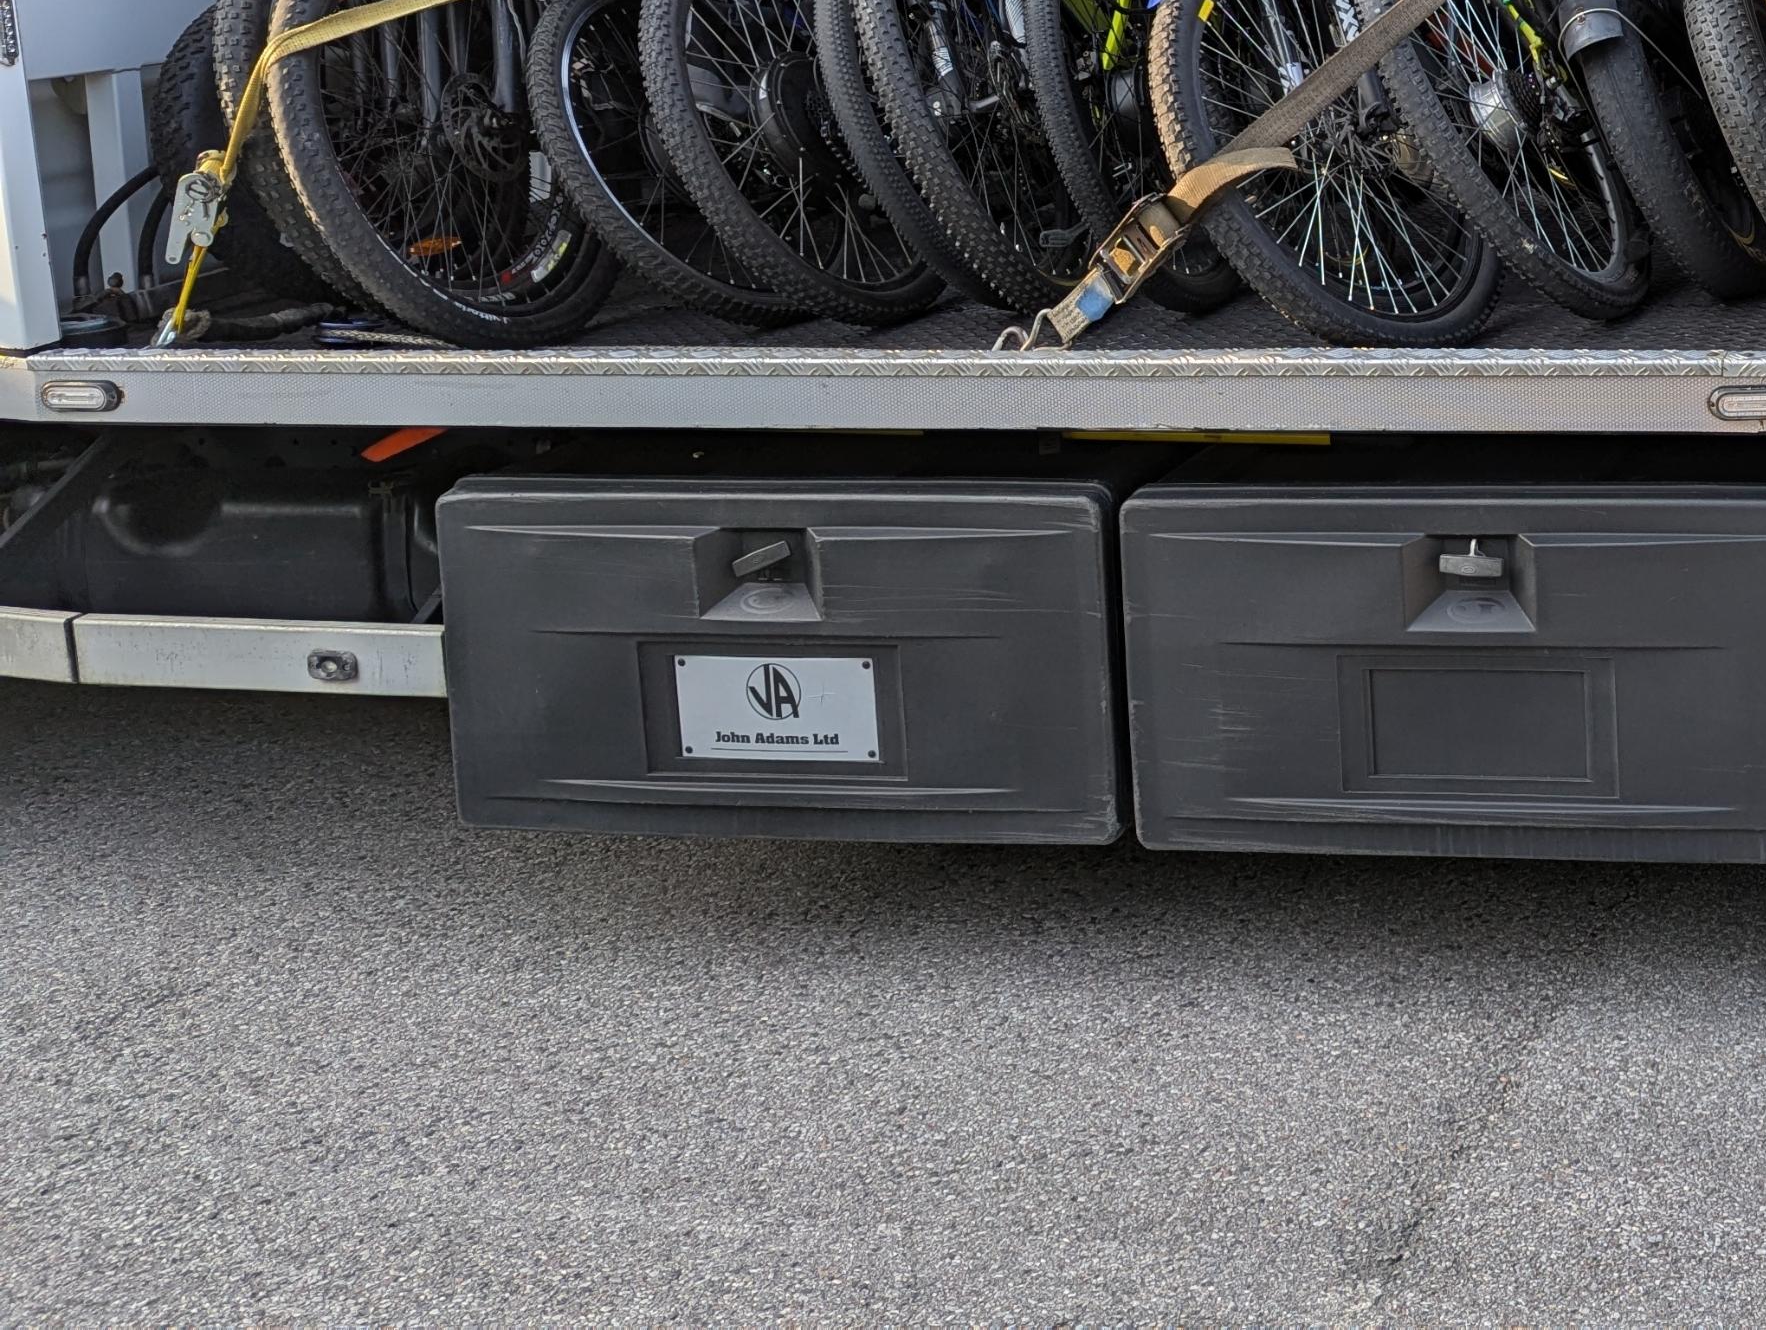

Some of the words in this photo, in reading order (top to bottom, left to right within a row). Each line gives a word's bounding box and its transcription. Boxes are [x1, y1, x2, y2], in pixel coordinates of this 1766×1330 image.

[715, 731, 751, 744] John
[755, 732, 809, 745] Adams
[813, 733, 840, 745] Ltd
